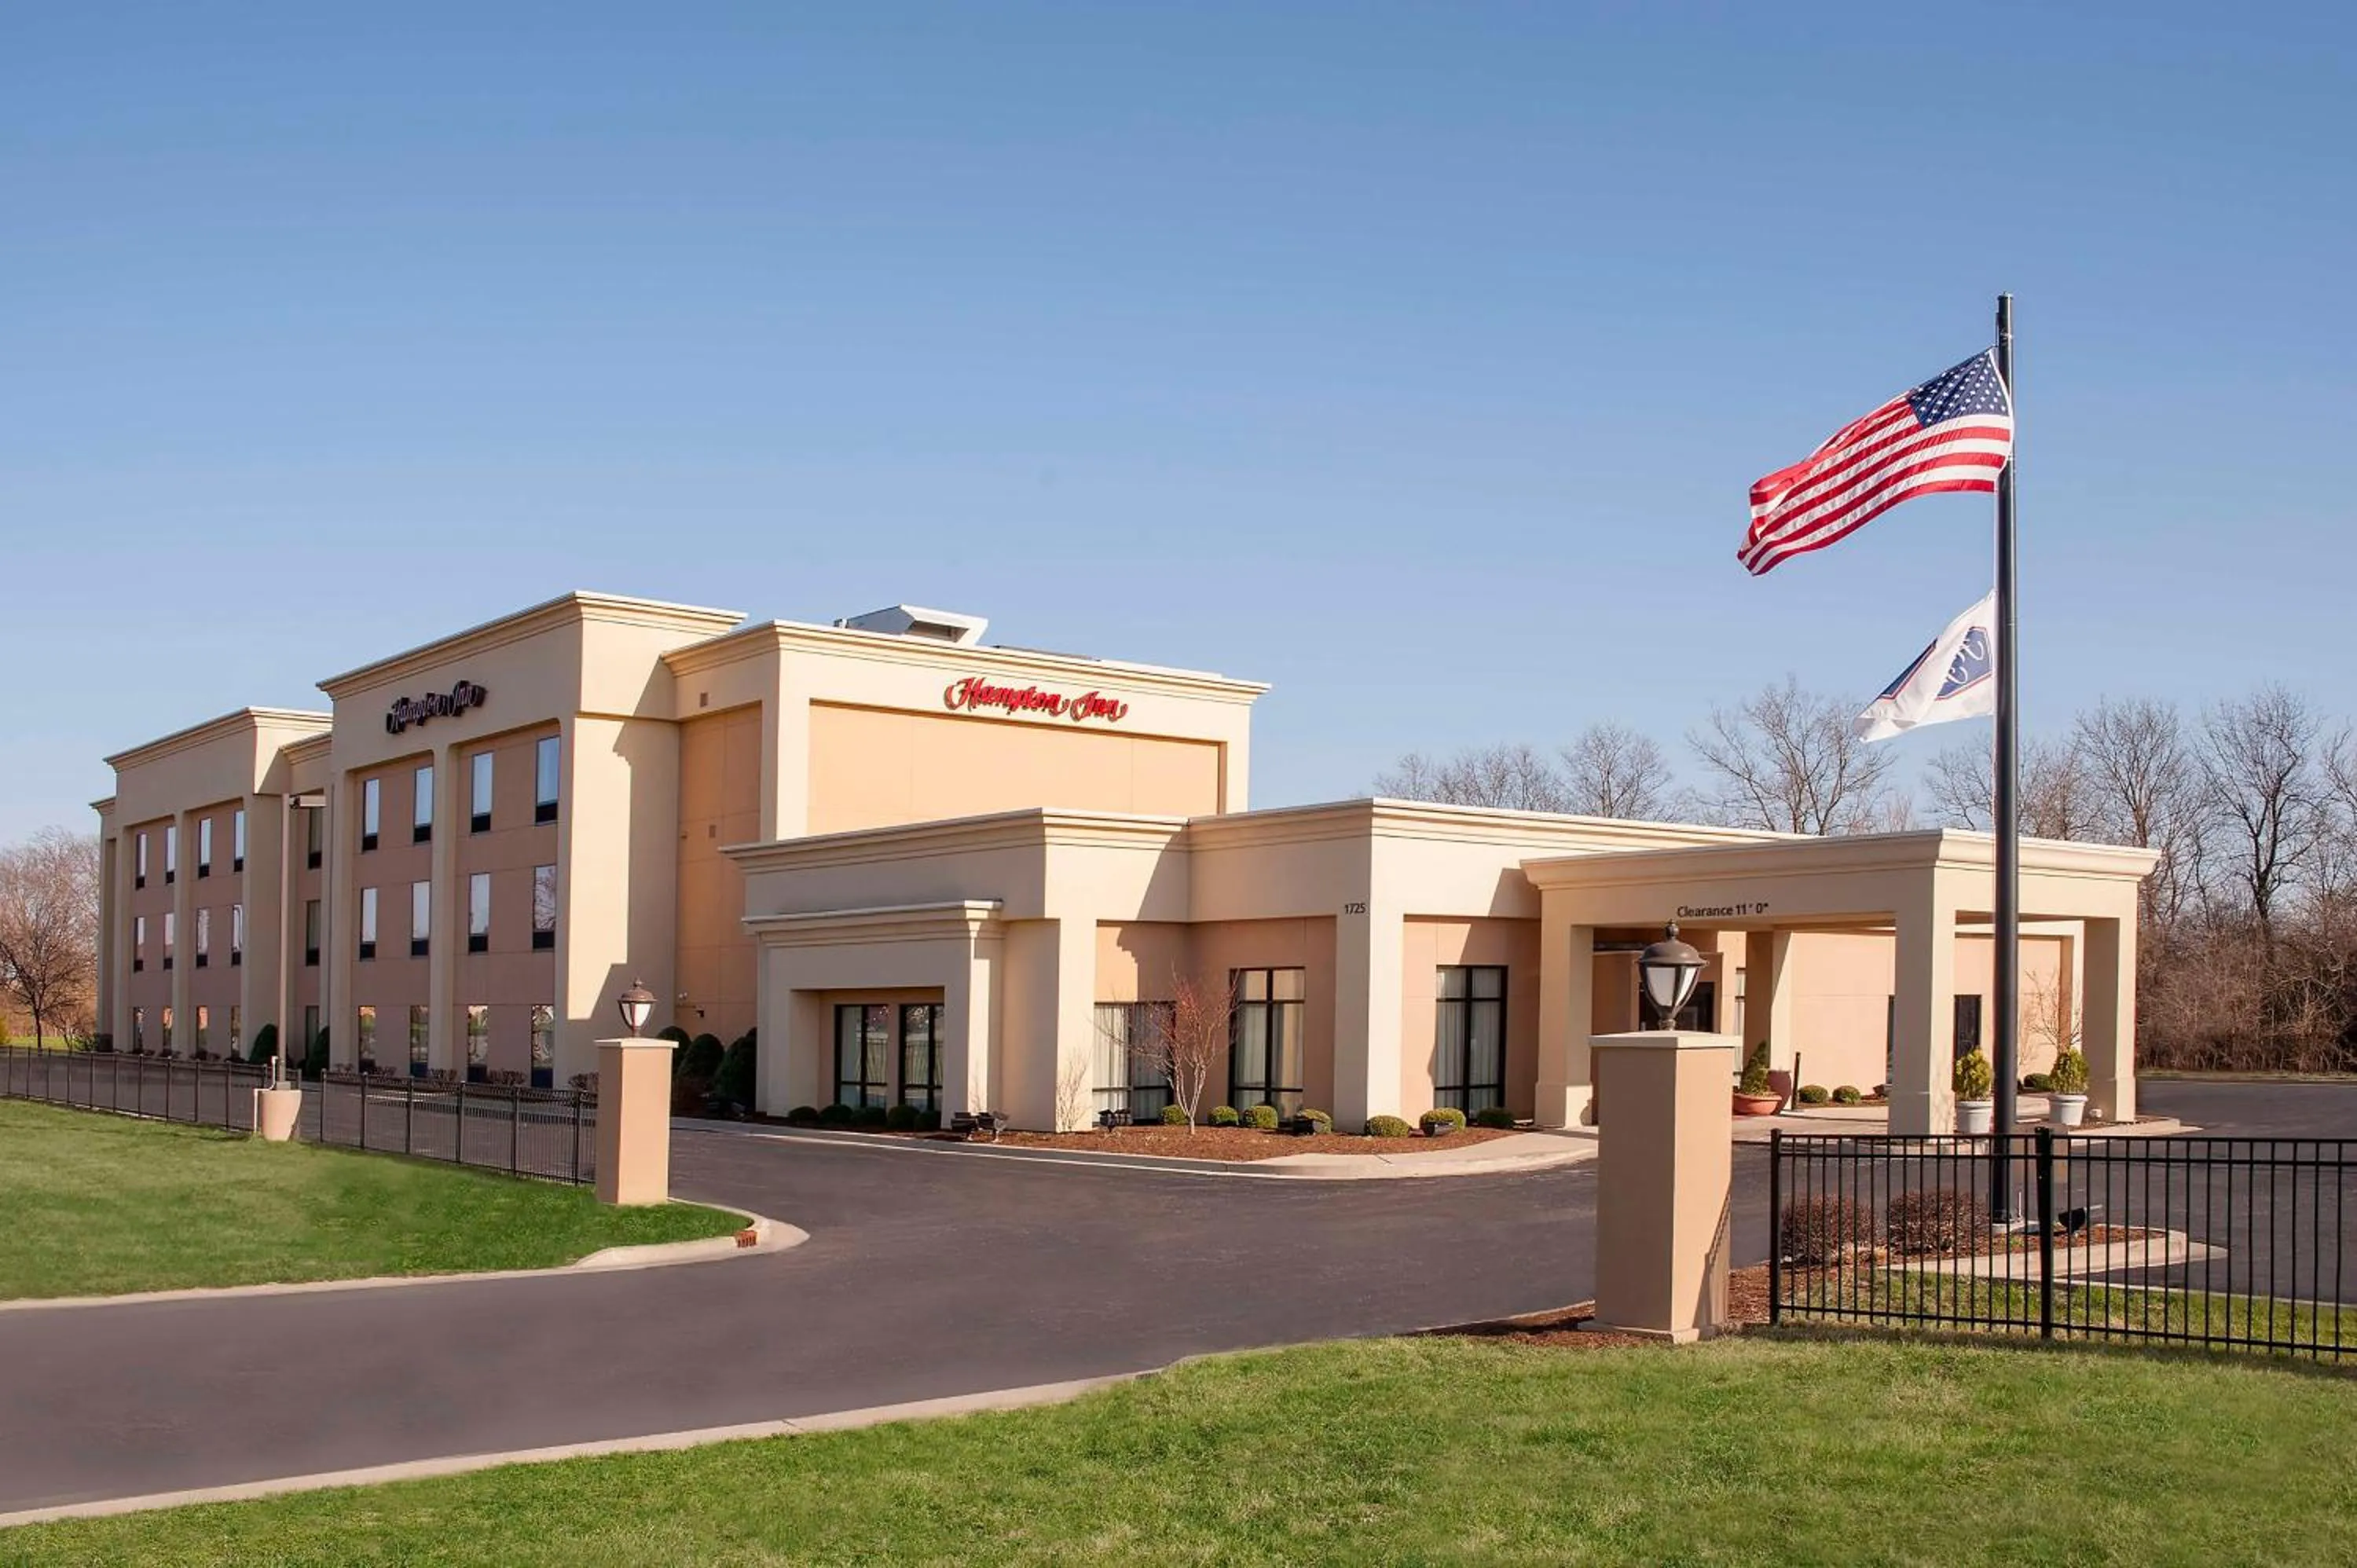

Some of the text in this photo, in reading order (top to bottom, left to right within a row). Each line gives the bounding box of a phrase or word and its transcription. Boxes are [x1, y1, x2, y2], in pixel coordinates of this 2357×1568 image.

[944, 677, 1129, 722] Hampton Inn
[1344, 903, 1366, 914] 1725
[1677, 906, 1733, 918] Clearance
